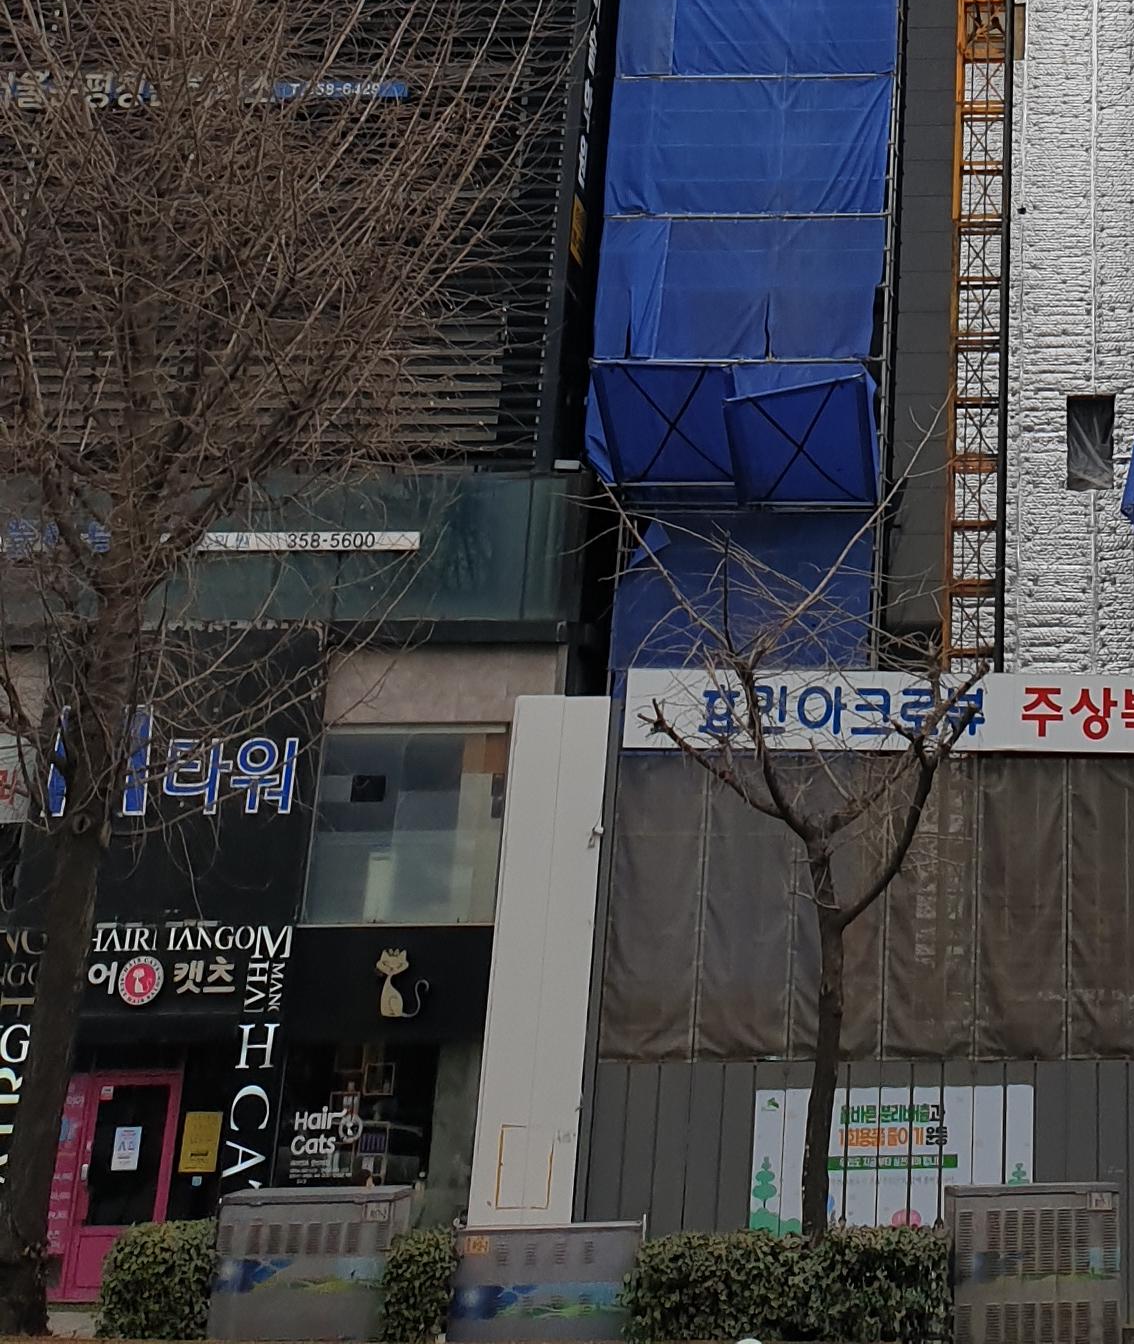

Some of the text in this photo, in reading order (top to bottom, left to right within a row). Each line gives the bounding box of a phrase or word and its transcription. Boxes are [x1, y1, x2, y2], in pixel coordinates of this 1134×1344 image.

[286, 532, 376, 550] 358-5600
[173, 955, 236, 995] 캣츠
[294, 1105, 347, 1131] Hair
[290, 1134, 337, 1155] Cats
